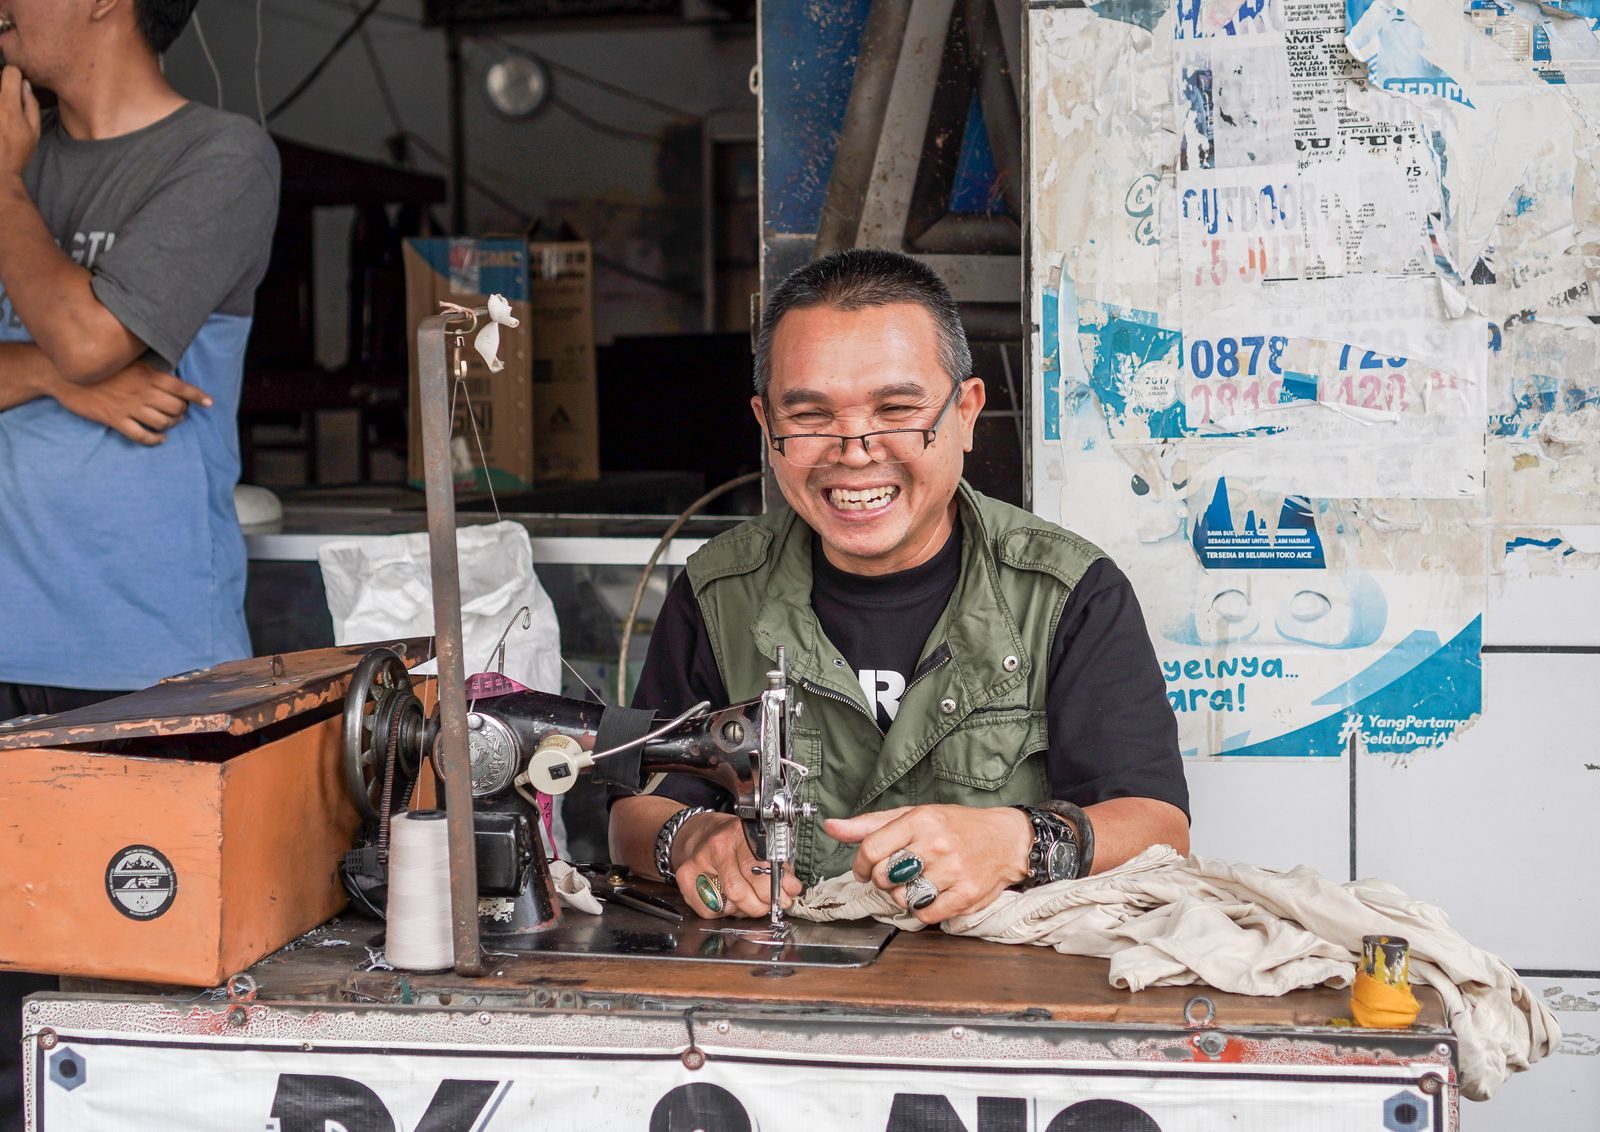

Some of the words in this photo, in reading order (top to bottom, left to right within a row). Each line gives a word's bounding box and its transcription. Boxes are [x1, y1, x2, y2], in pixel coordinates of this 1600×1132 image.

[1206, 551, 1237, 559] TERSEDIA
[1238, 551, 1245, 559] DI
[1245, 551, 1275, 559] SELURUH
[1276, 551, 1296, 559] TOKO
[1296, 551, 1312, 559] AICE
